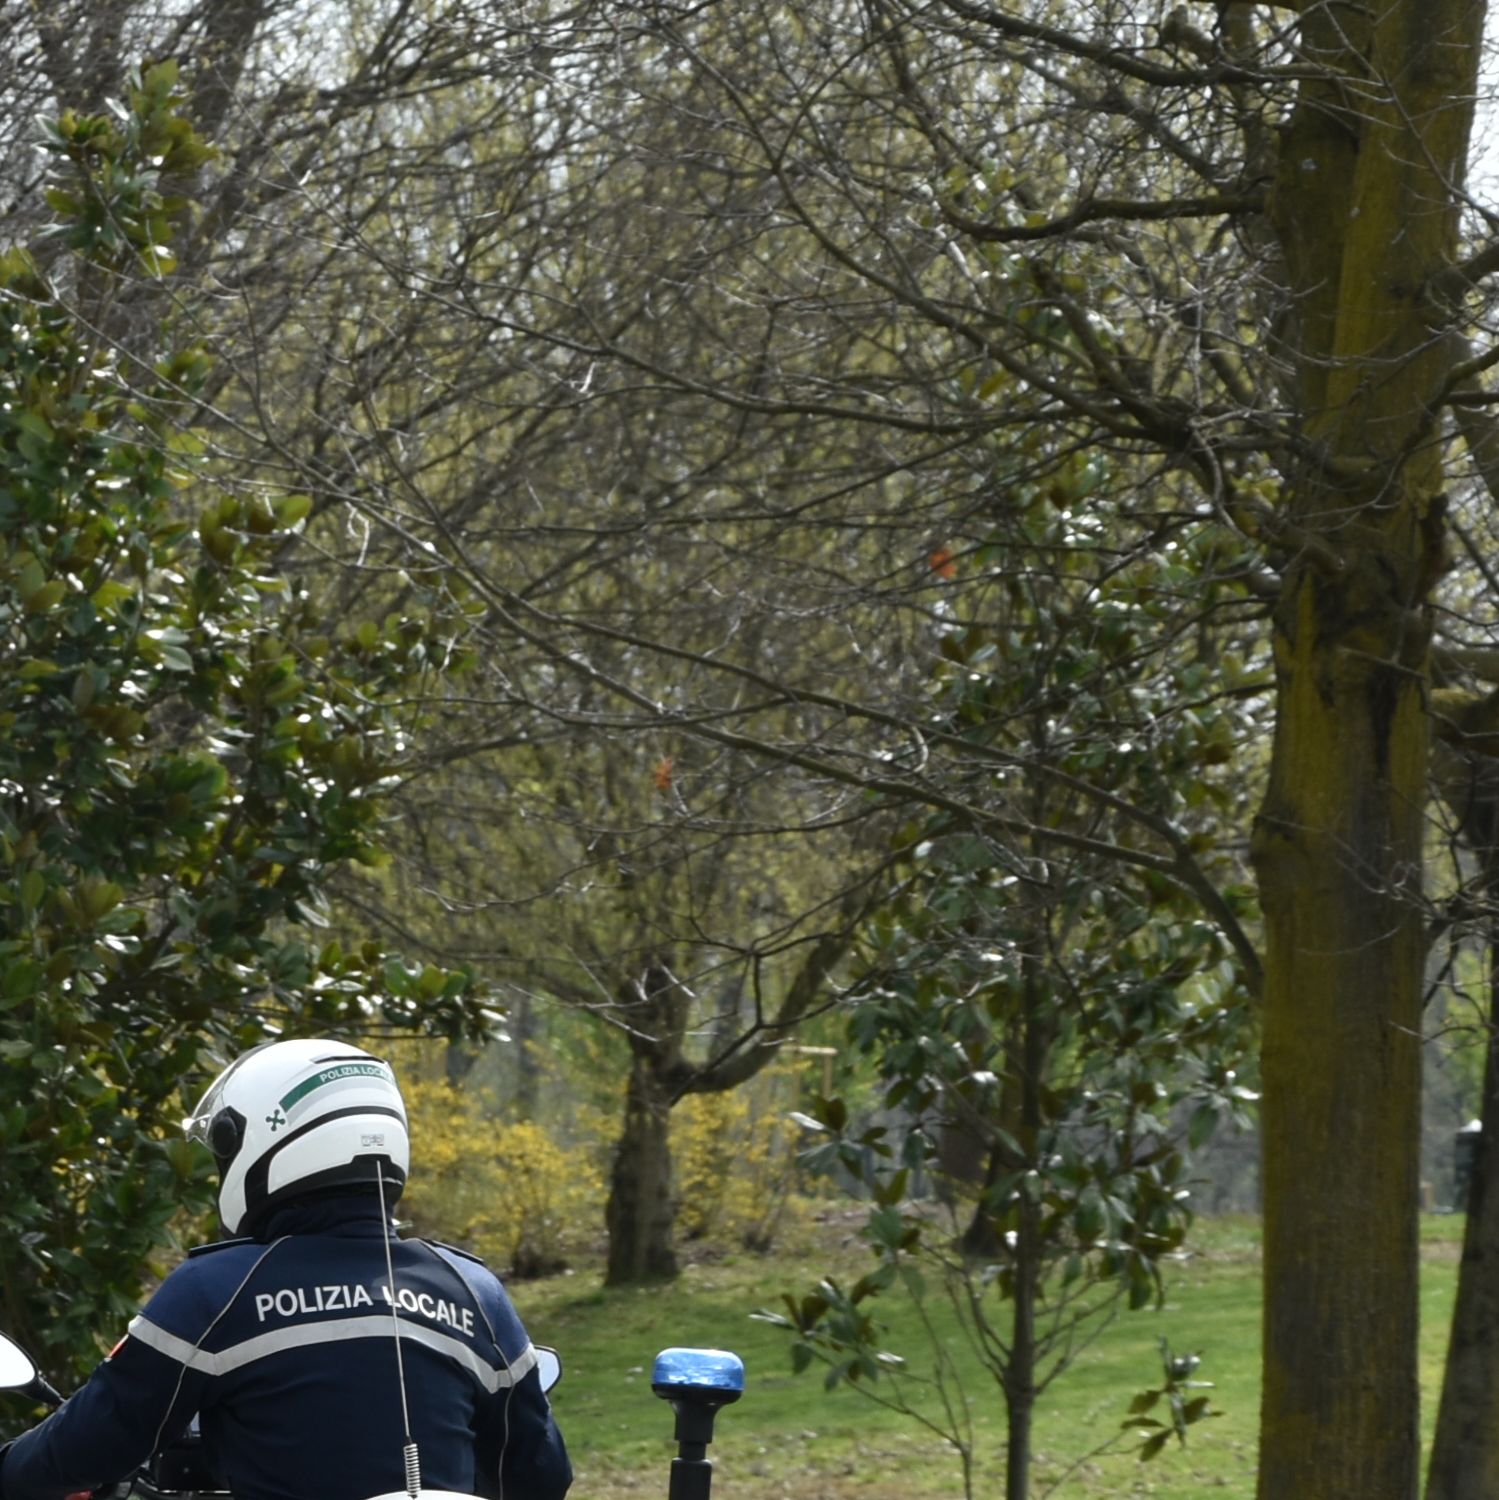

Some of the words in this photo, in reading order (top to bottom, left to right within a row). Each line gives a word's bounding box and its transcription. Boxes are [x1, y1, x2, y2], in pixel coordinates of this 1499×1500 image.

[319, 1066, 360, 1082] POLIZIA
[255, 1284, 374, 1322] POLIZIA
[381, 1285, 475, 1338] LOCALE
